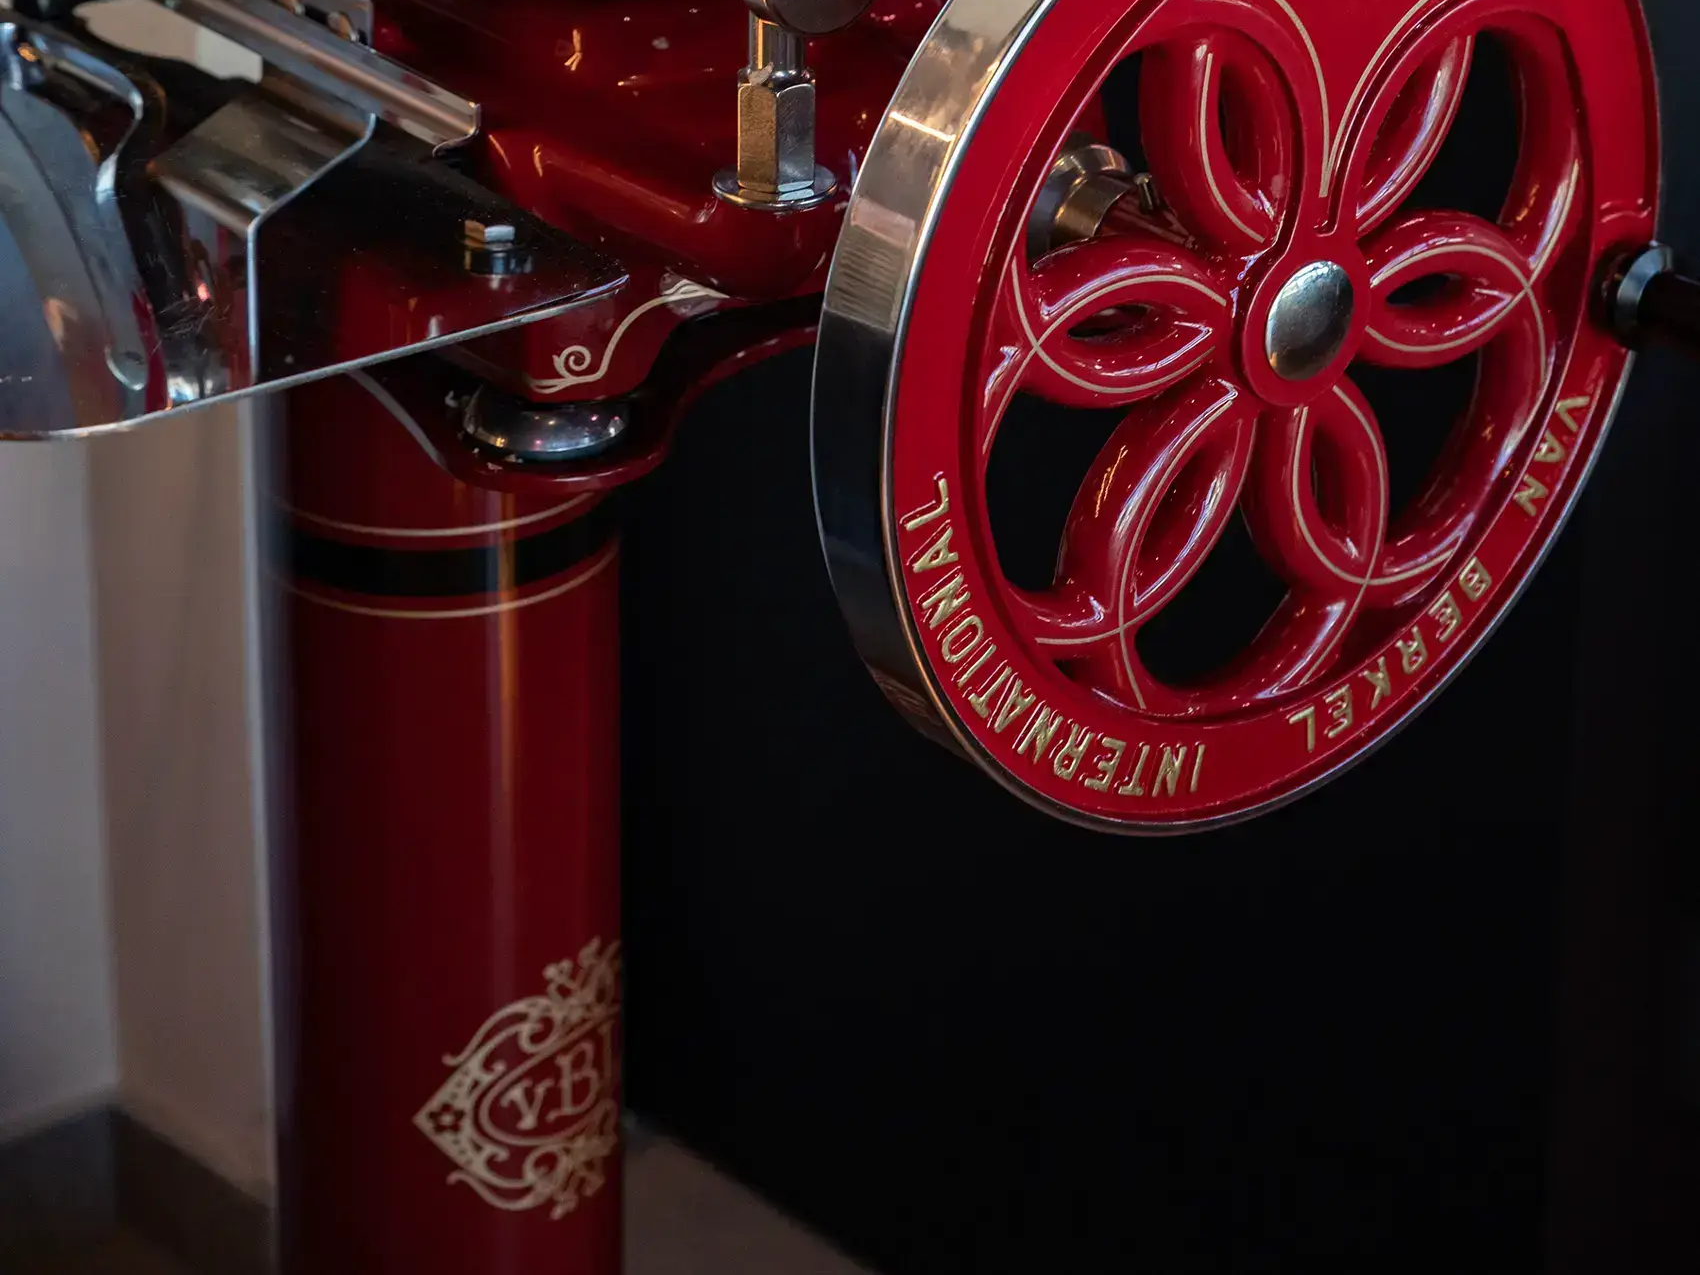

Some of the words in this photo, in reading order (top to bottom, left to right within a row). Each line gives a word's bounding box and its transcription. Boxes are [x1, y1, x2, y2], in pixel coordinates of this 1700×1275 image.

[1514, 395, 1590, 517] VAN
[903, 476, 1207, 797] INTERNATIONAL
[1287, 556, 1493, 753] BERKEL
